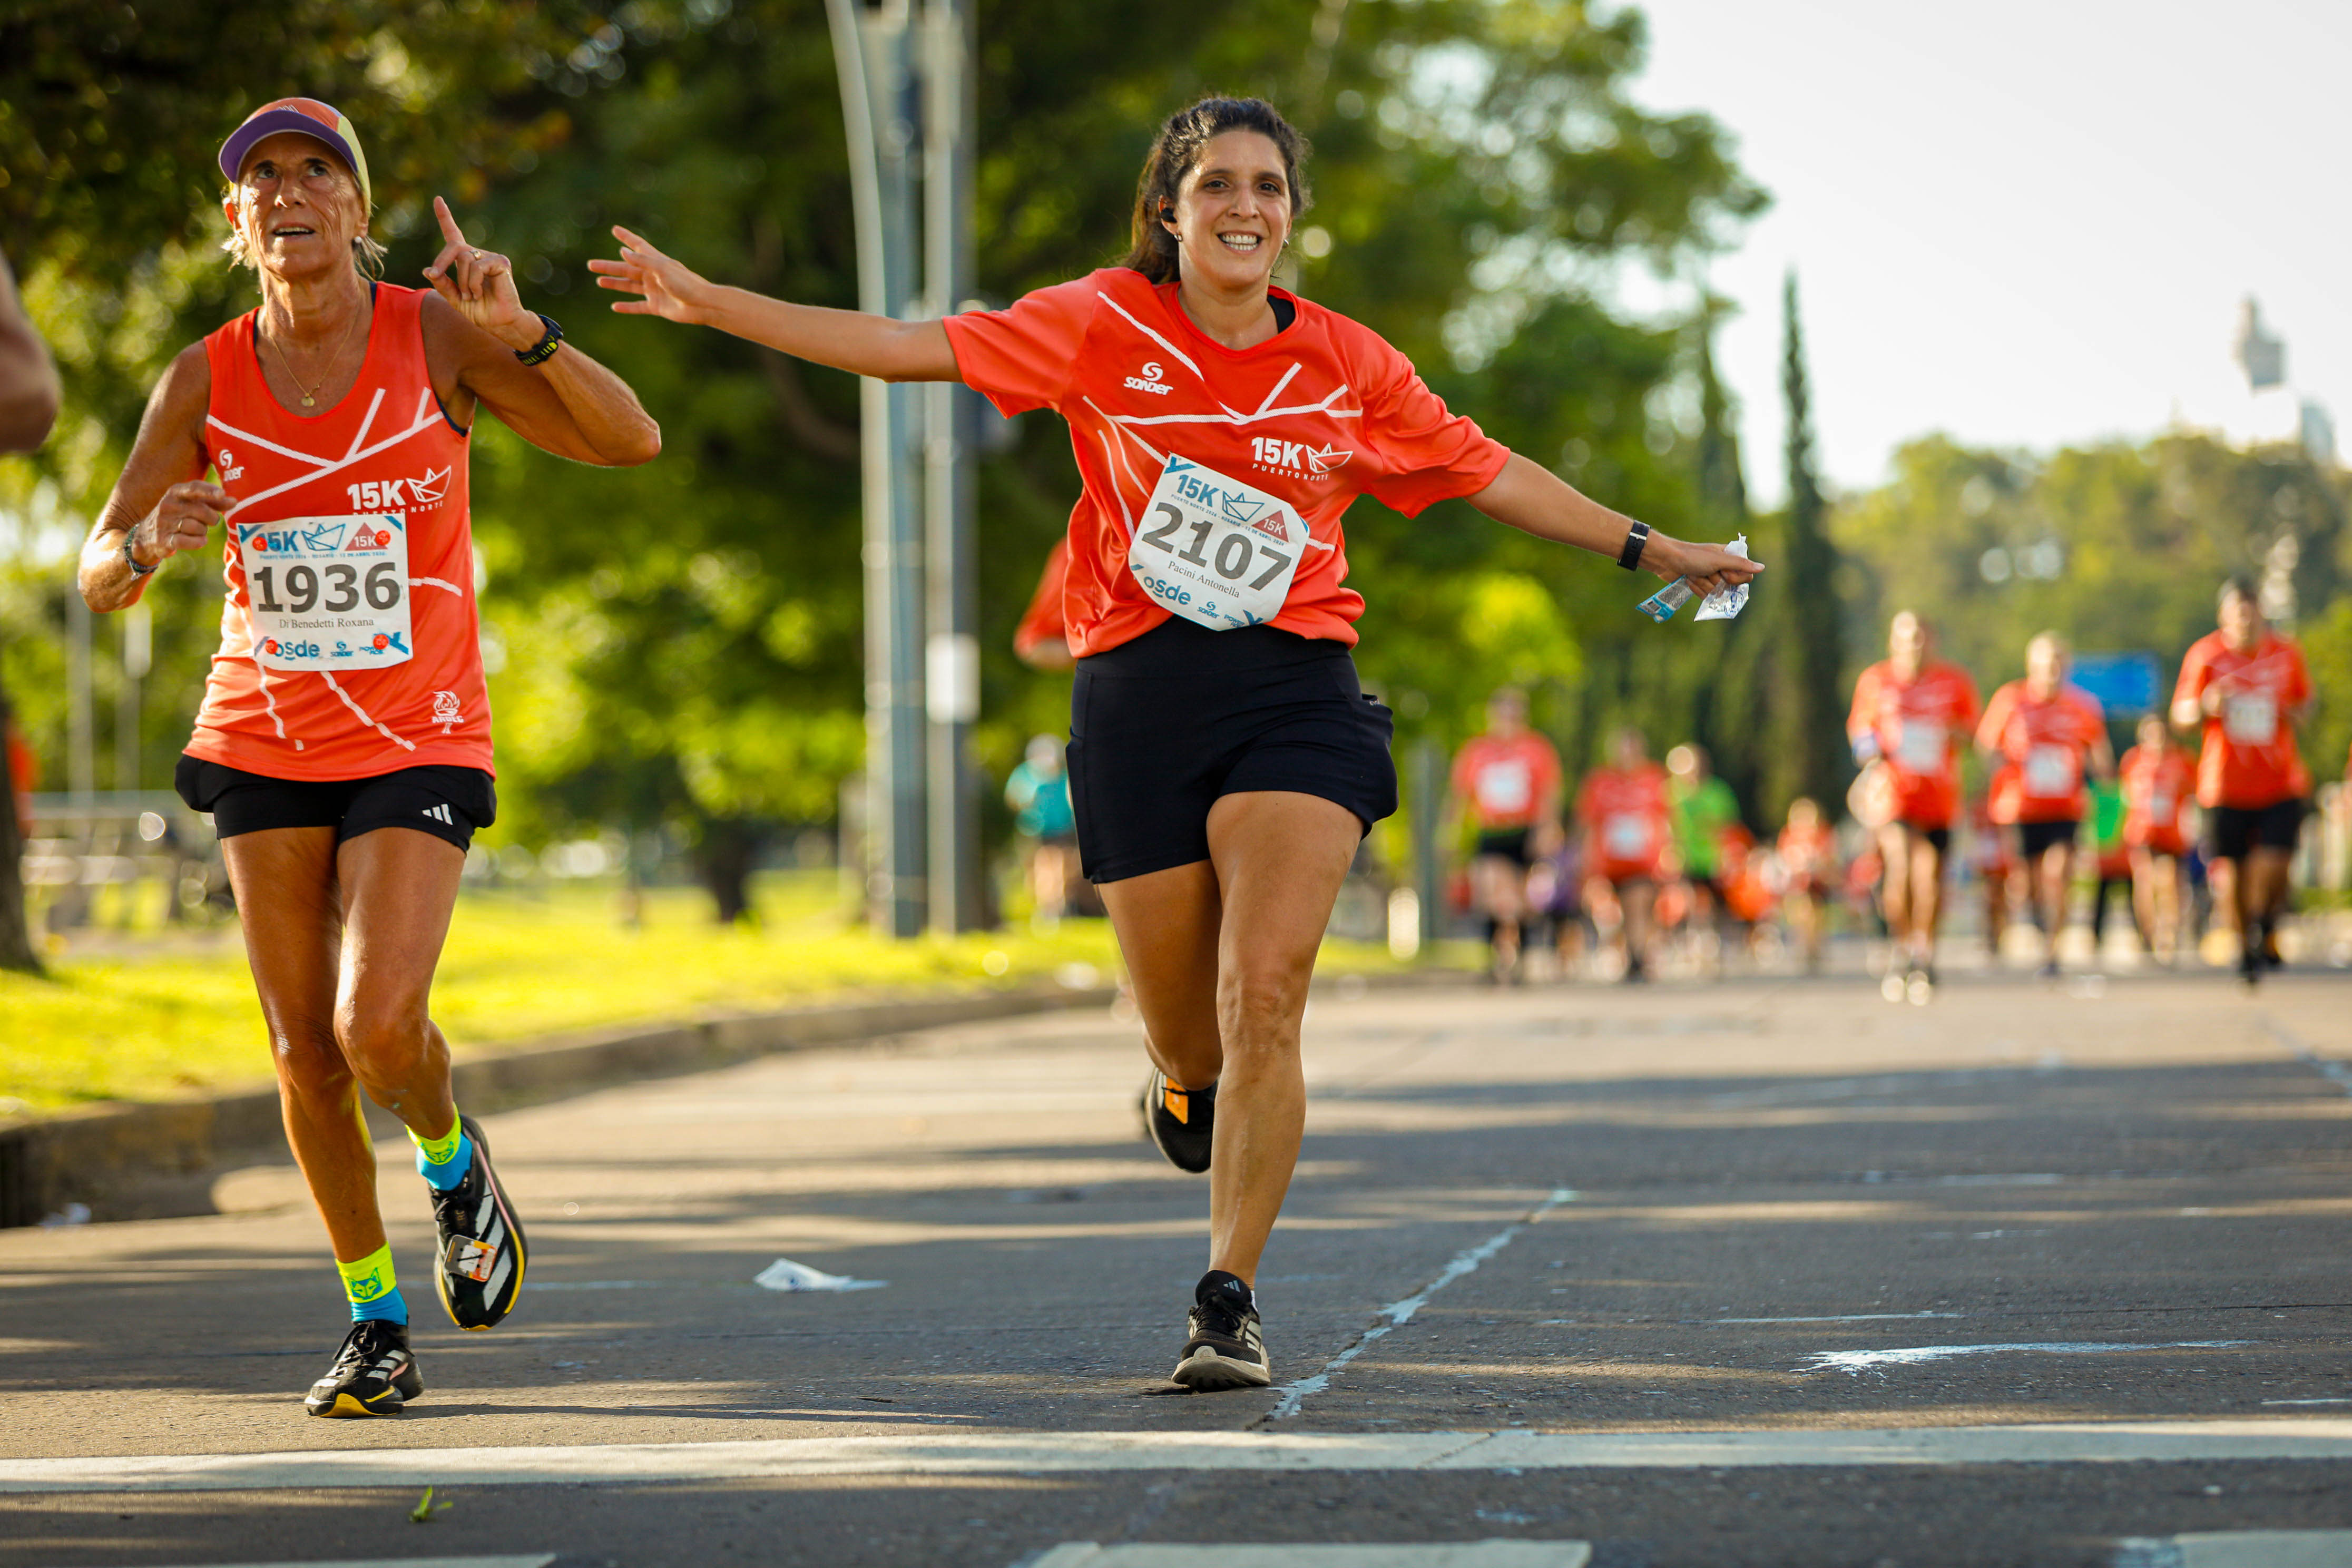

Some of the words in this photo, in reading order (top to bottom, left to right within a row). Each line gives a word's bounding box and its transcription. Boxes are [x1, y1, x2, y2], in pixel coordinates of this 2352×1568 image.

[1251, 437, 1304, 469] 15K
[1252, 463, 1299, 479] PUERTO
[347, 480, 406, 510] 15K
[1171, 494, 1189, 504] PUERTO
[1190, 502, 1205, 511] NORTE
[1177, 474, 1220, 507] 15K
[411, 501, 443, 513] NORTE
[1264, 518, 1285, 535] 15K
[1142, 502, 1292, 591] 2107
[254, 562, 400, 613] 1936
[1143, 576, 1191, 605] osde
[1168, 561, 1196, 579] Pacini
[1197, 574, 1240, 598] Antonella
[279, 619, 289, 628] Di
[291, 619, 334, 628] Benedetti
[337, 618, 374, 628] Roxana
